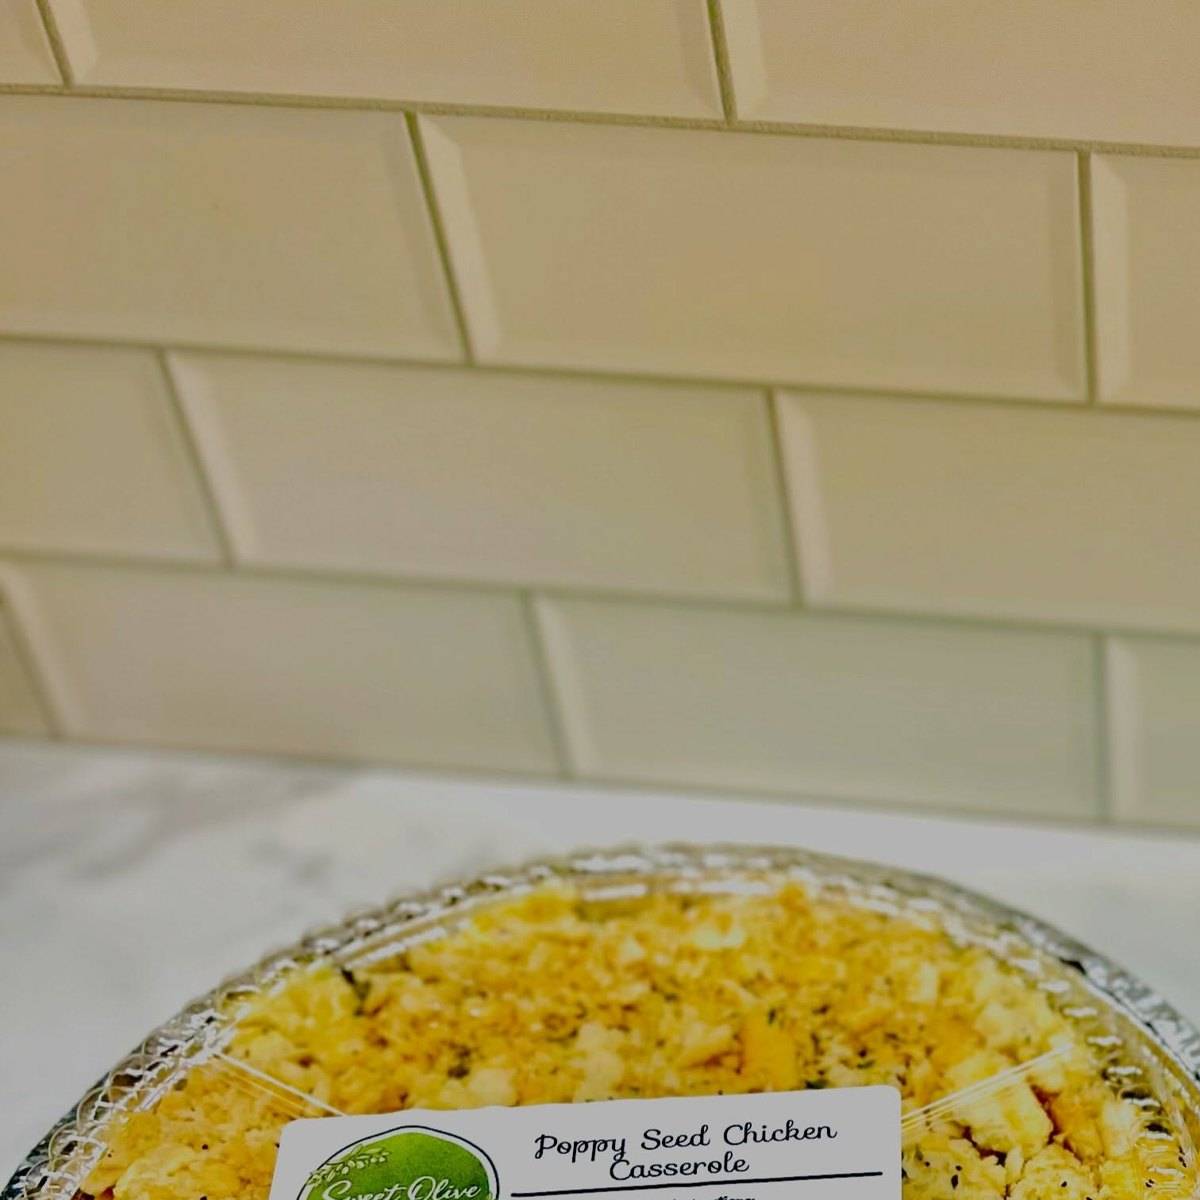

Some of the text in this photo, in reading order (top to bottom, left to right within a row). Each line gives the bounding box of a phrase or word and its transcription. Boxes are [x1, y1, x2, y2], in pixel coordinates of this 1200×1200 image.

[534, 1119, 838, 1163] Poppy Seed Chicken
[609, 1151, 750, 1181] Casserole
